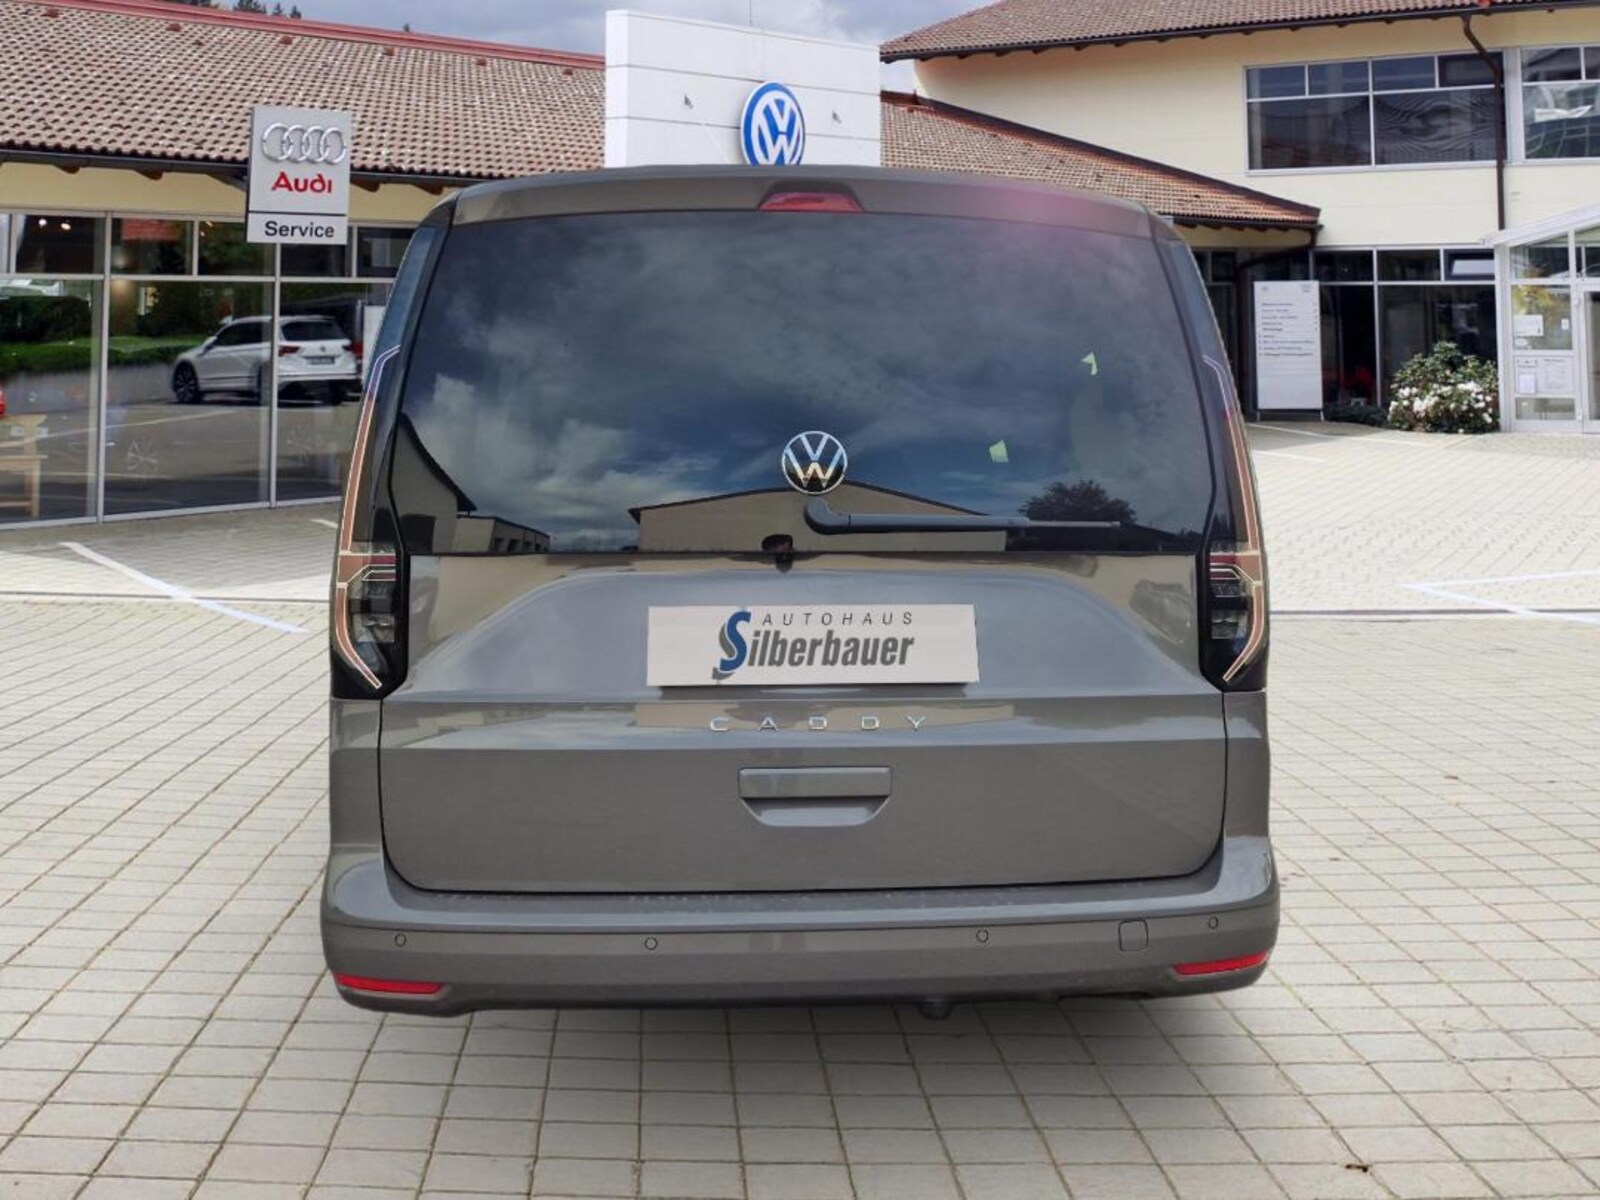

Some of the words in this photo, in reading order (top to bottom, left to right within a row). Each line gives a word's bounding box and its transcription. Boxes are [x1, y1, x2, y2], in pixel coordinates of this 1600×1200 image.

[271, 171, 332, 194] Audi
[264, 220, 335, 238] Service
[762, 611, 914, 626] AUTOHAUS
[713, 611, 914, 678] Silberbauer
[709, 715, 926, 732] CADDY
